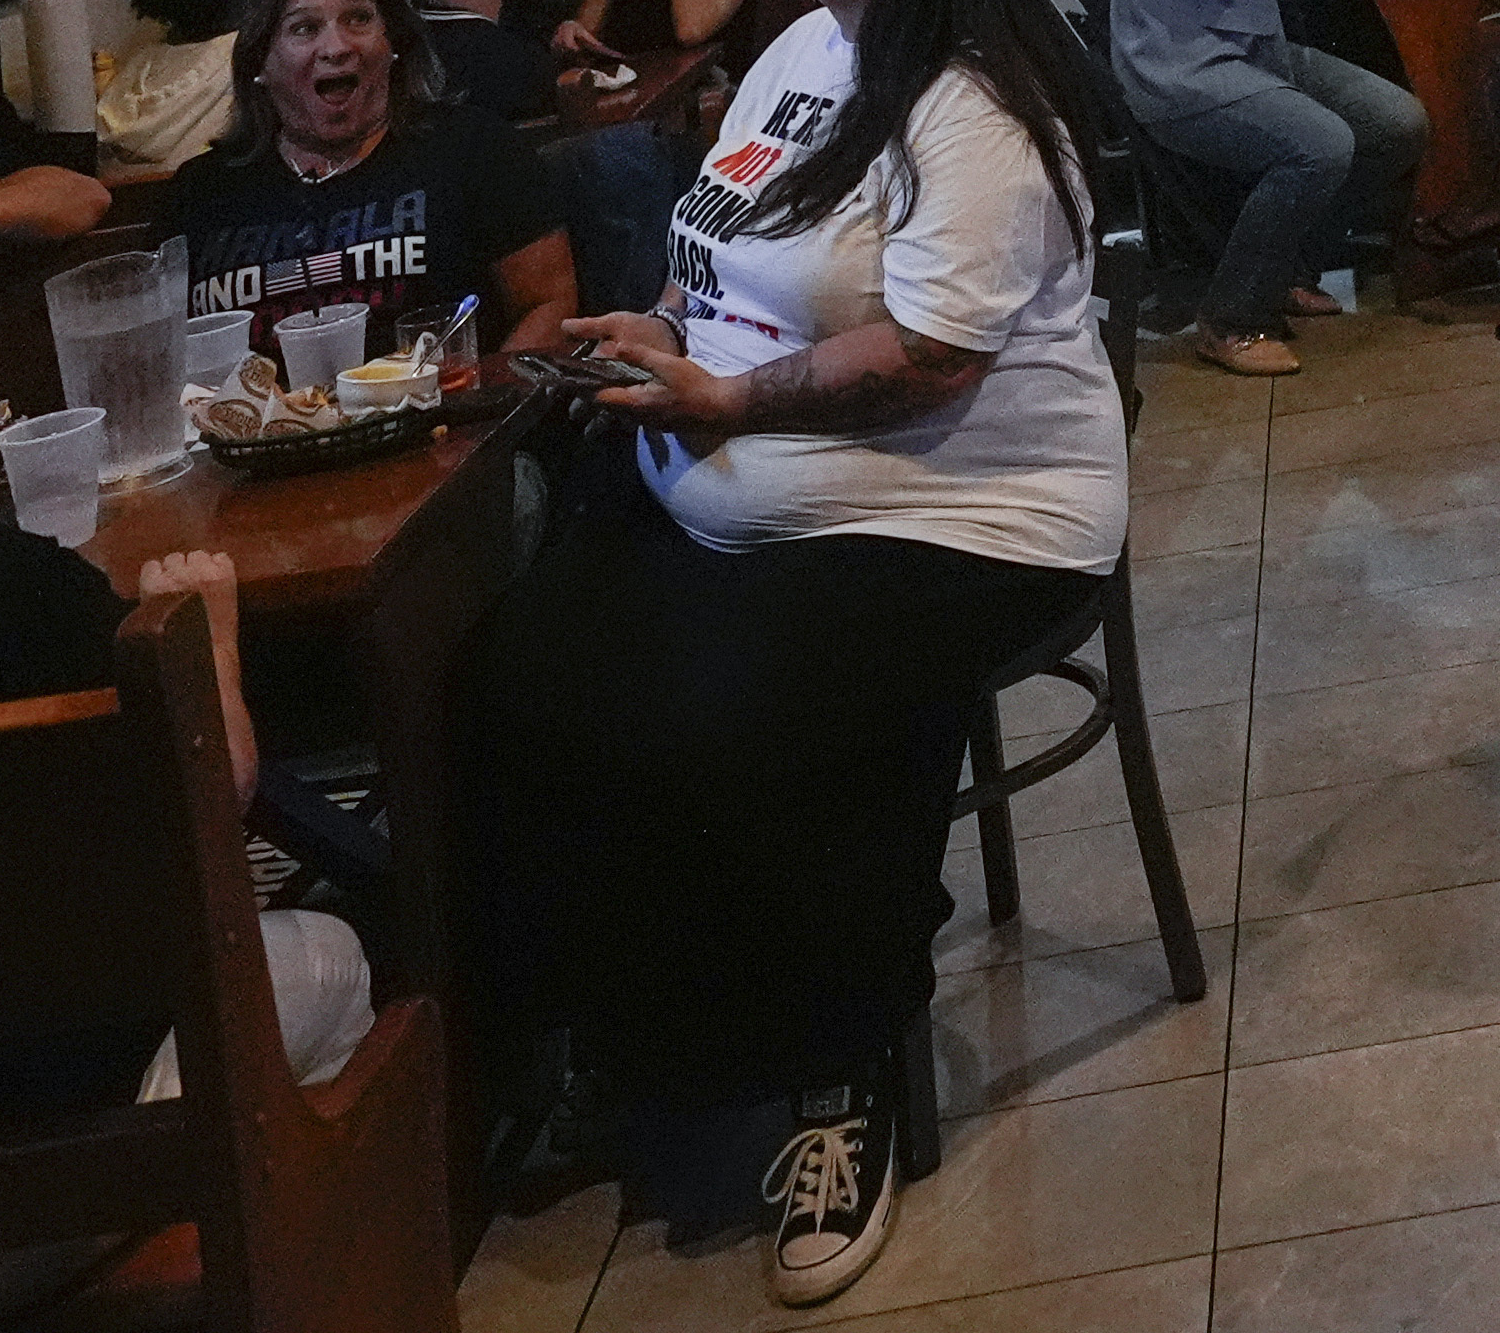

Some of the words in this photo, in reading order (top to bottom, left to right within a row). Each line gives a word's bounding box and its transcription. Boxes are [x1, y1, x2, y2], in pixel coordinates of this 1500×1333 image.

[711, 140, 783, 187] NOT
[192, 265, 262, 317] AND
[346, 235, 427, 281] THE
